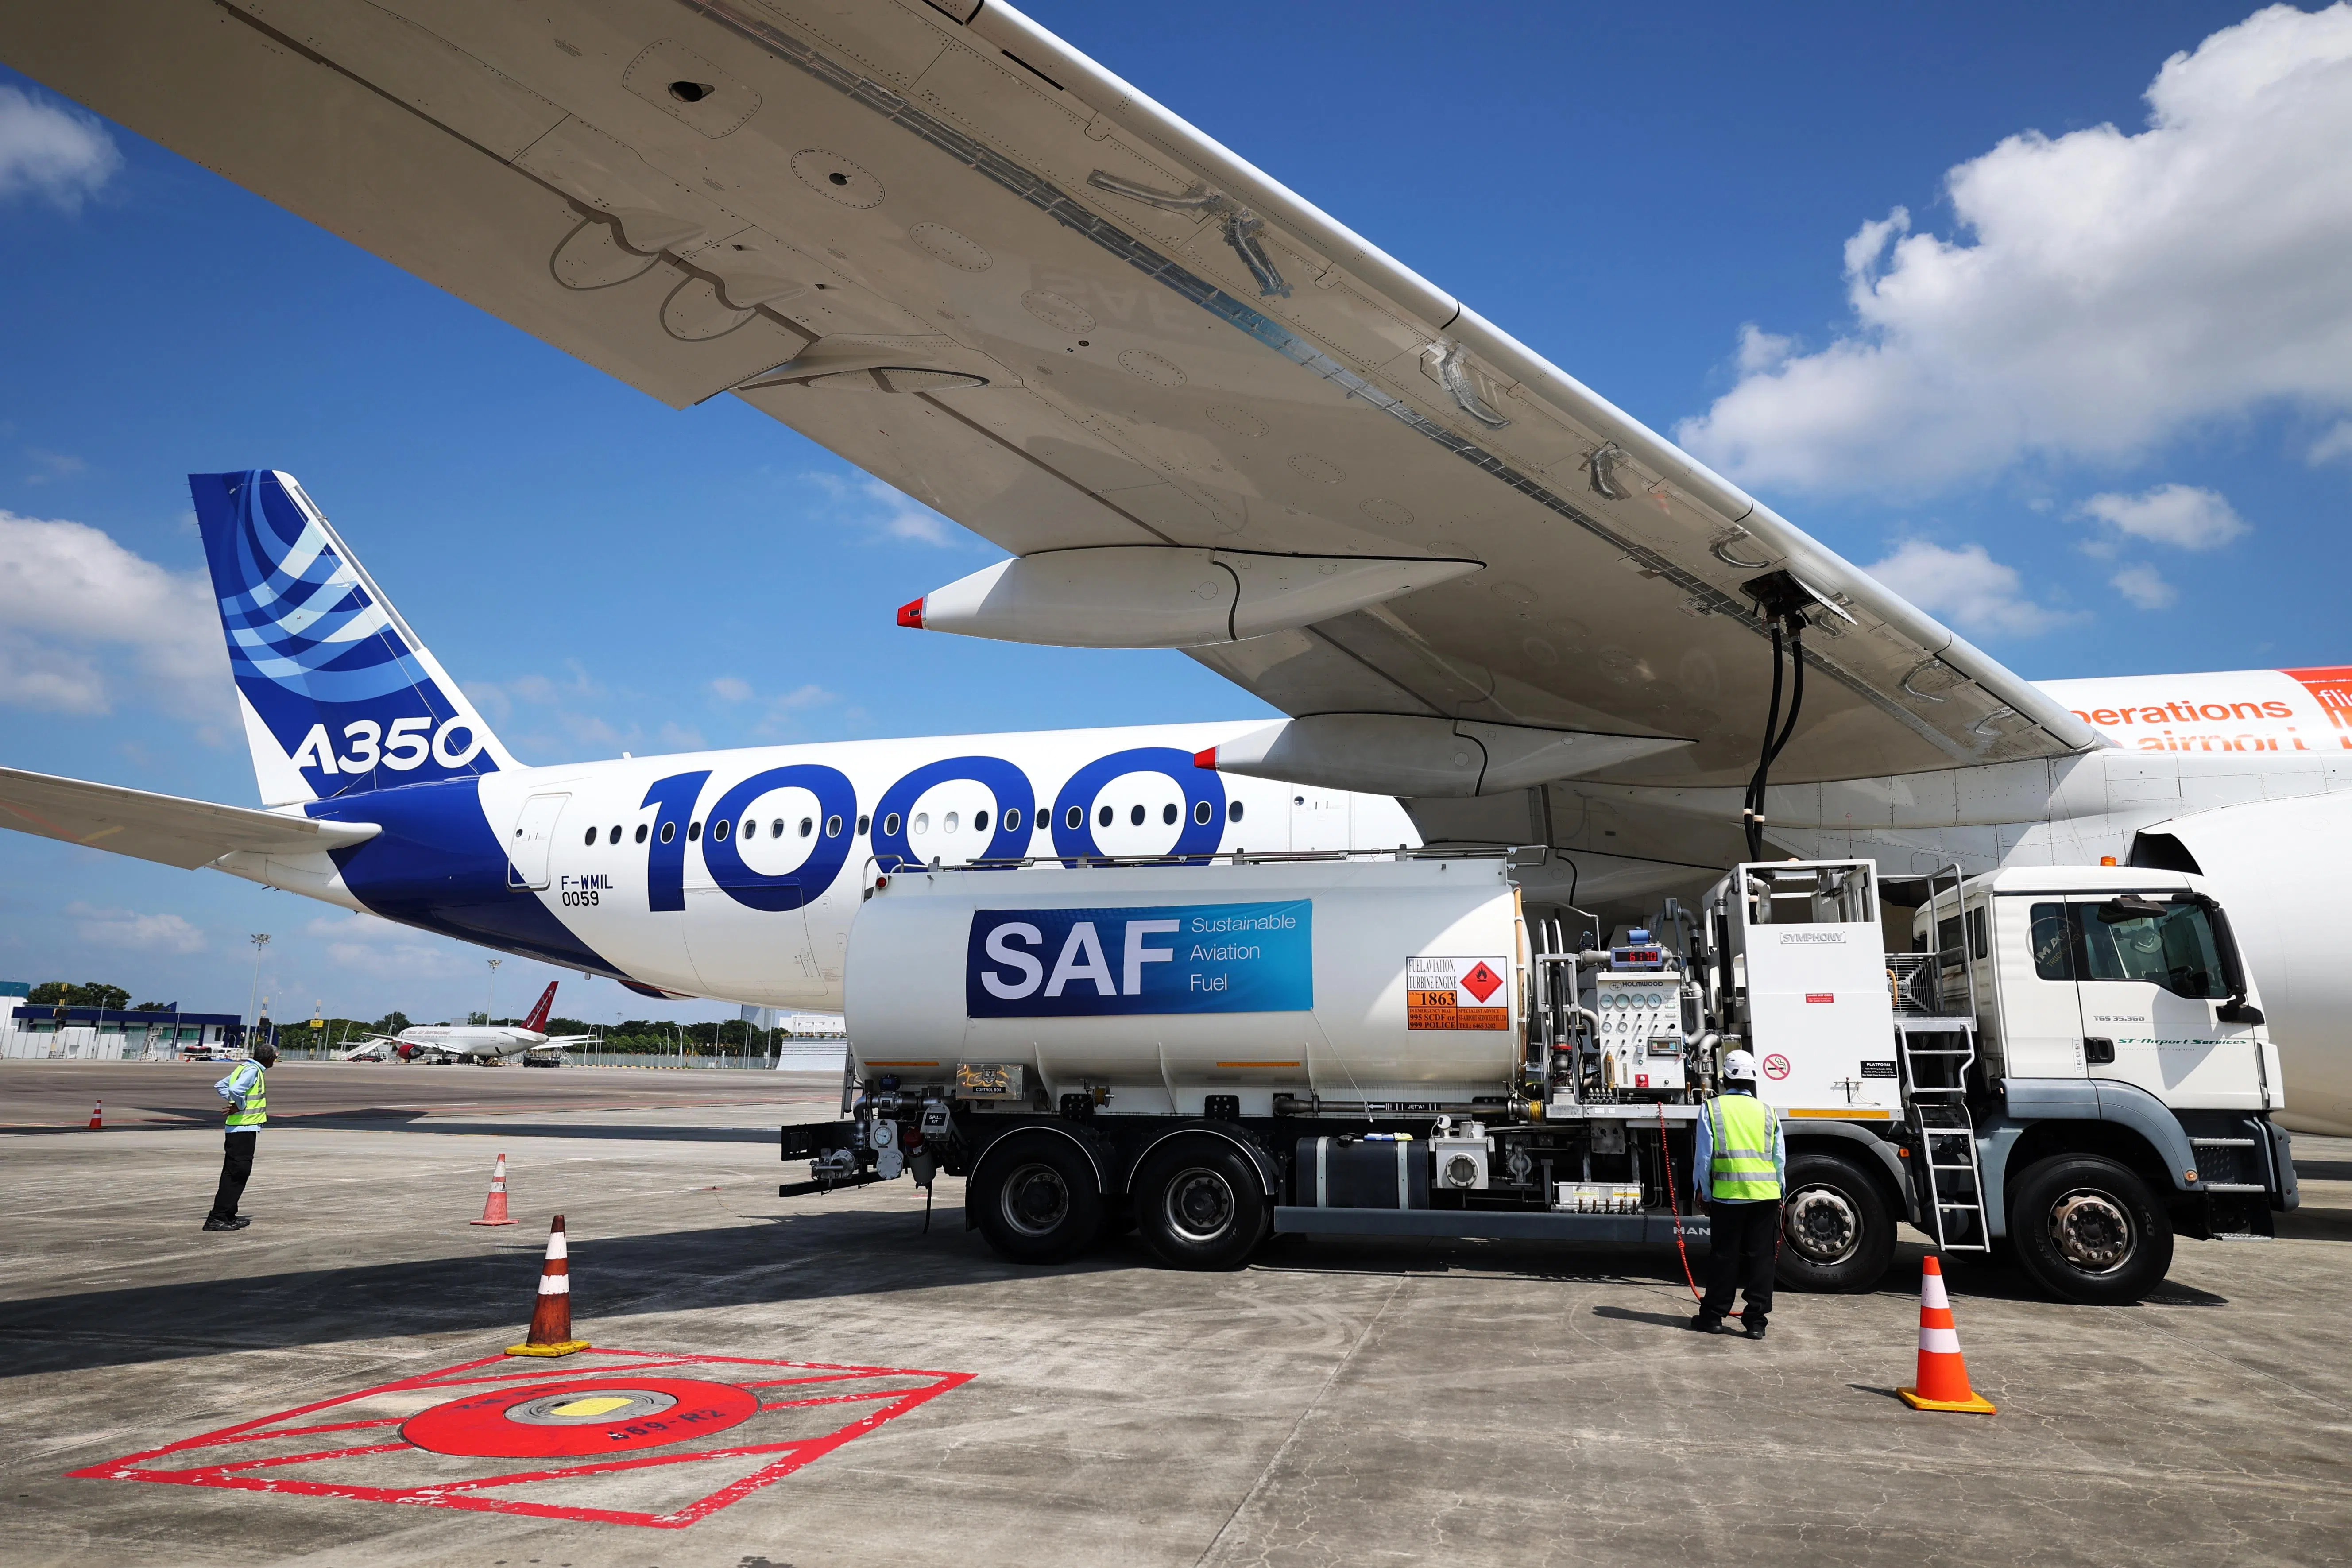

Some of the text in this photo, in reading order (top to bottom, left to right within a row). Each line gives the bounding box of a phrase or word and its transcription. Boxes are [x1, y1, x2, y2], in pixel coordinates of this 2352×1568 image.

[2317, 689, 2352, 707] fli
[290, 716, 485, 774] A350
[639, 747, 1226, 912] 1000
[561, 874, 613, 890] F-WMIL
[562, 890, 599, 906] 0059
[1191, 914, 1296, 933] Sustainable
[1783, 933, 1843, 942] SYMPHONY
[981, 919, 1180, 999] SAF
[1190, 943, 1260, 961] Aviation
[1629, 952, 1657, 961] 6170
[1191, 973, 1227, 991] Fuel
[1409, 976, 1457, 989] TURBINE ENGINE
[1420, 992, 1455, 1005] 1863
